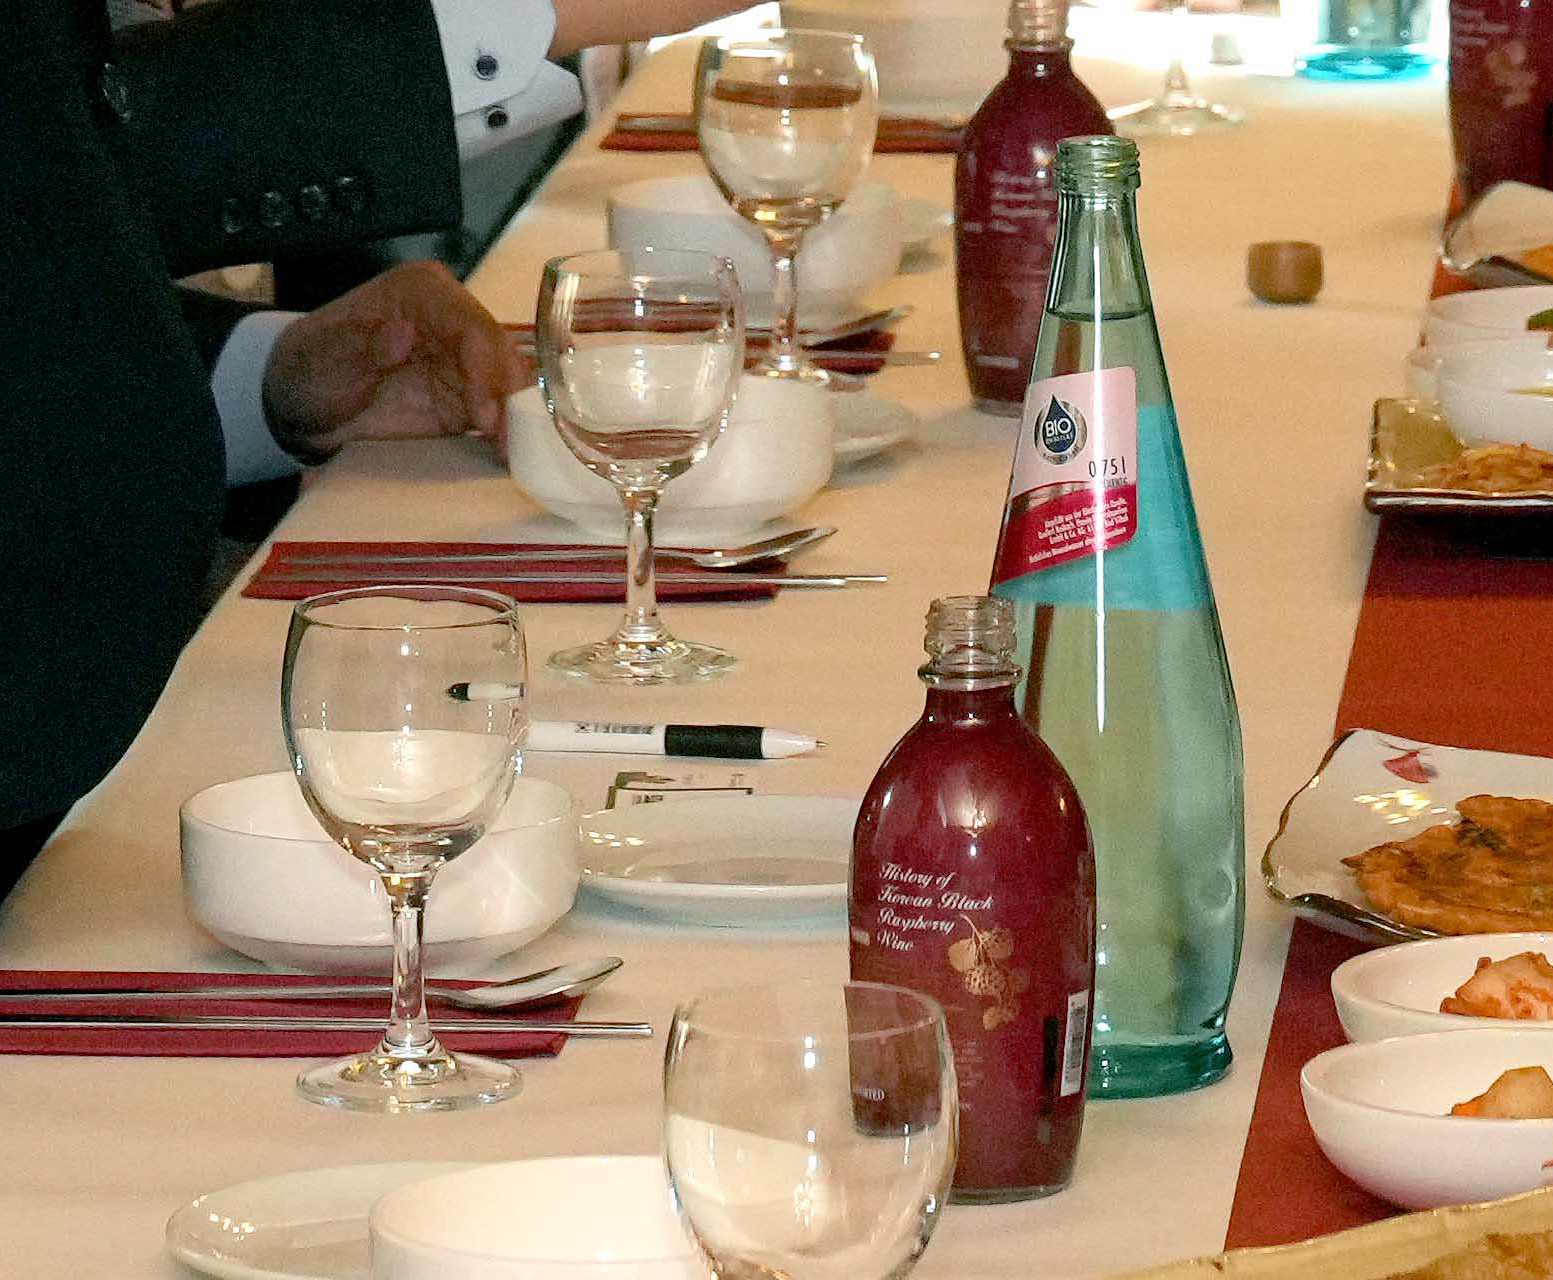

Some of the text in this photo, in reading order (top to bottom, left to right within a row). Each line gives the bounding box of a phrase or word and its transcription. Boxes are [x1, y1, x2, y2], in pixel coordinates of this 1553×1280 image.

[1045, 418, 1072, 437] BIO
[1088, 458, 1118, 478] 075
[878, 862, 957, 890] History of
[878, 884, 993, 910] Korean Black
[877, 907, 955, 935] Raspberry
[877, 929, 914, 951] Wine
